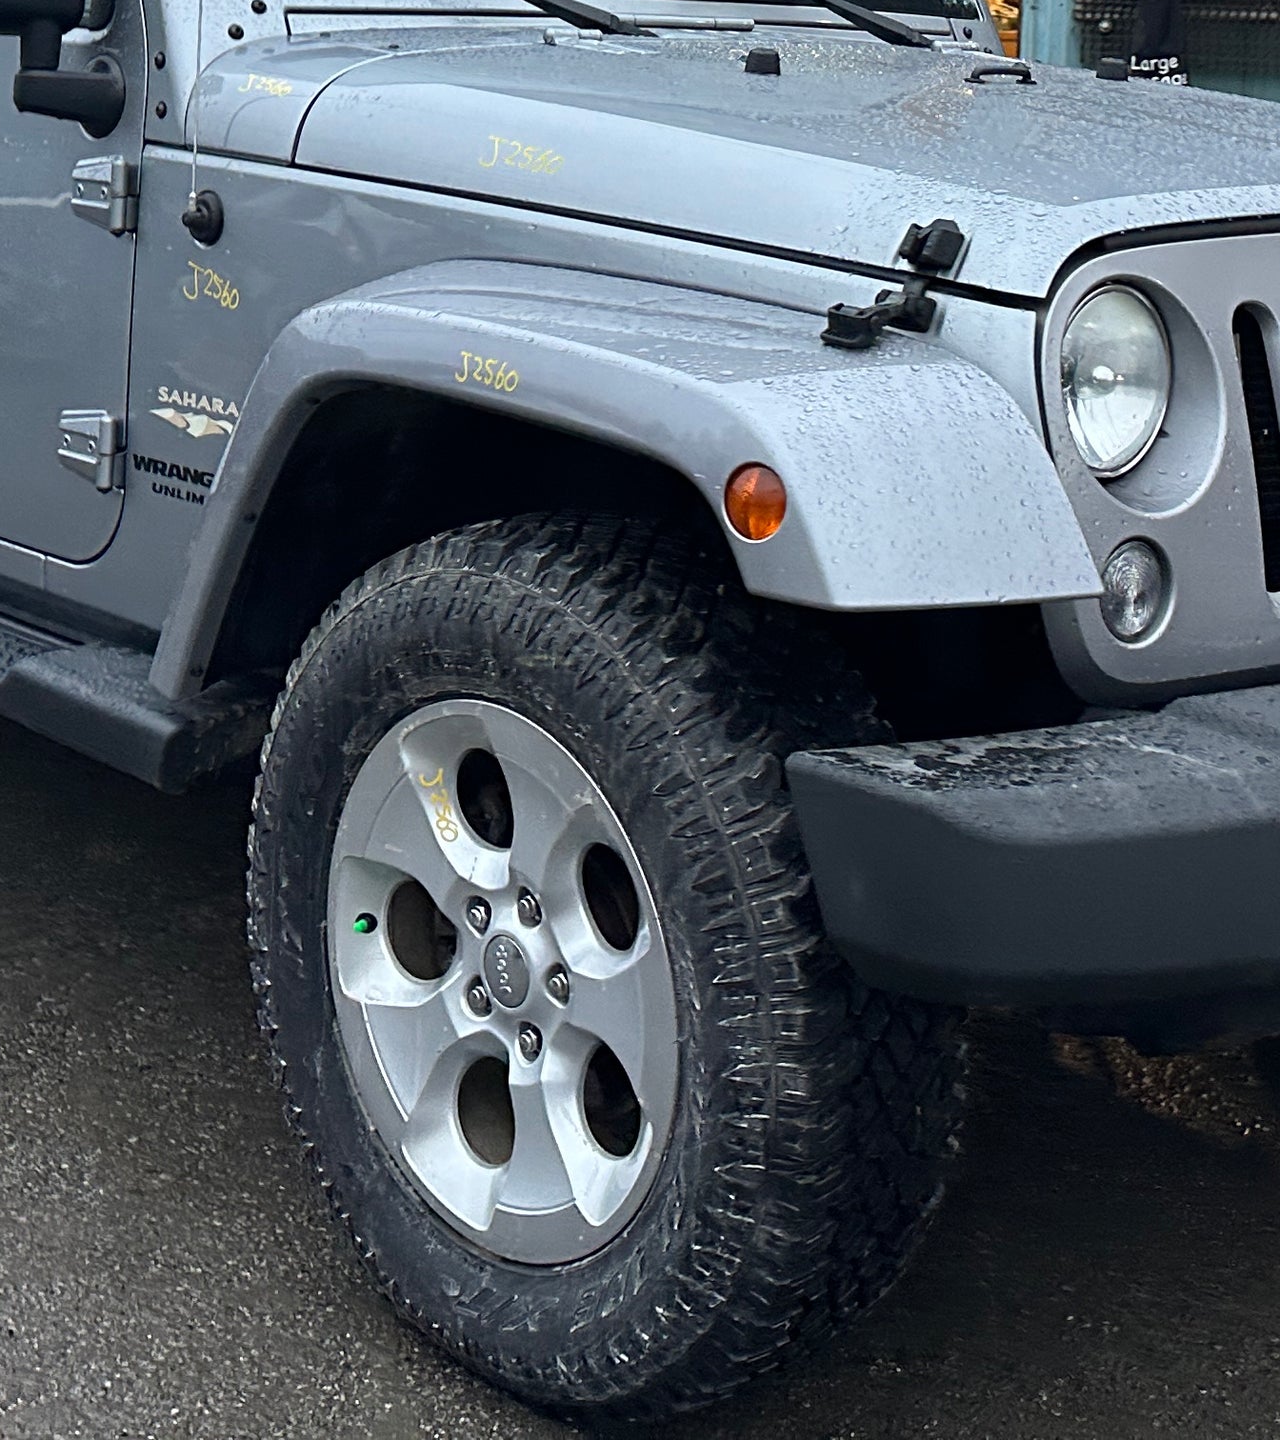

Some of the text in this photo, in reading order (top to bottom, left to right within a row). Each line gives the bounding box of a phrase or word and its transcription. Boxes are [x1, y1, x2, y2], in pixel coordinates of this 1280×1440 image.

[1130, 55, 1180, 75] Large
[478, 134, 565, 175] J2560
[454, 350, 519, 393] J2560
[157, 385, 240, 418] SAHARA
[132, 453, 216, 488] WRANG
[151, 482, 205, 505] UNLIM
